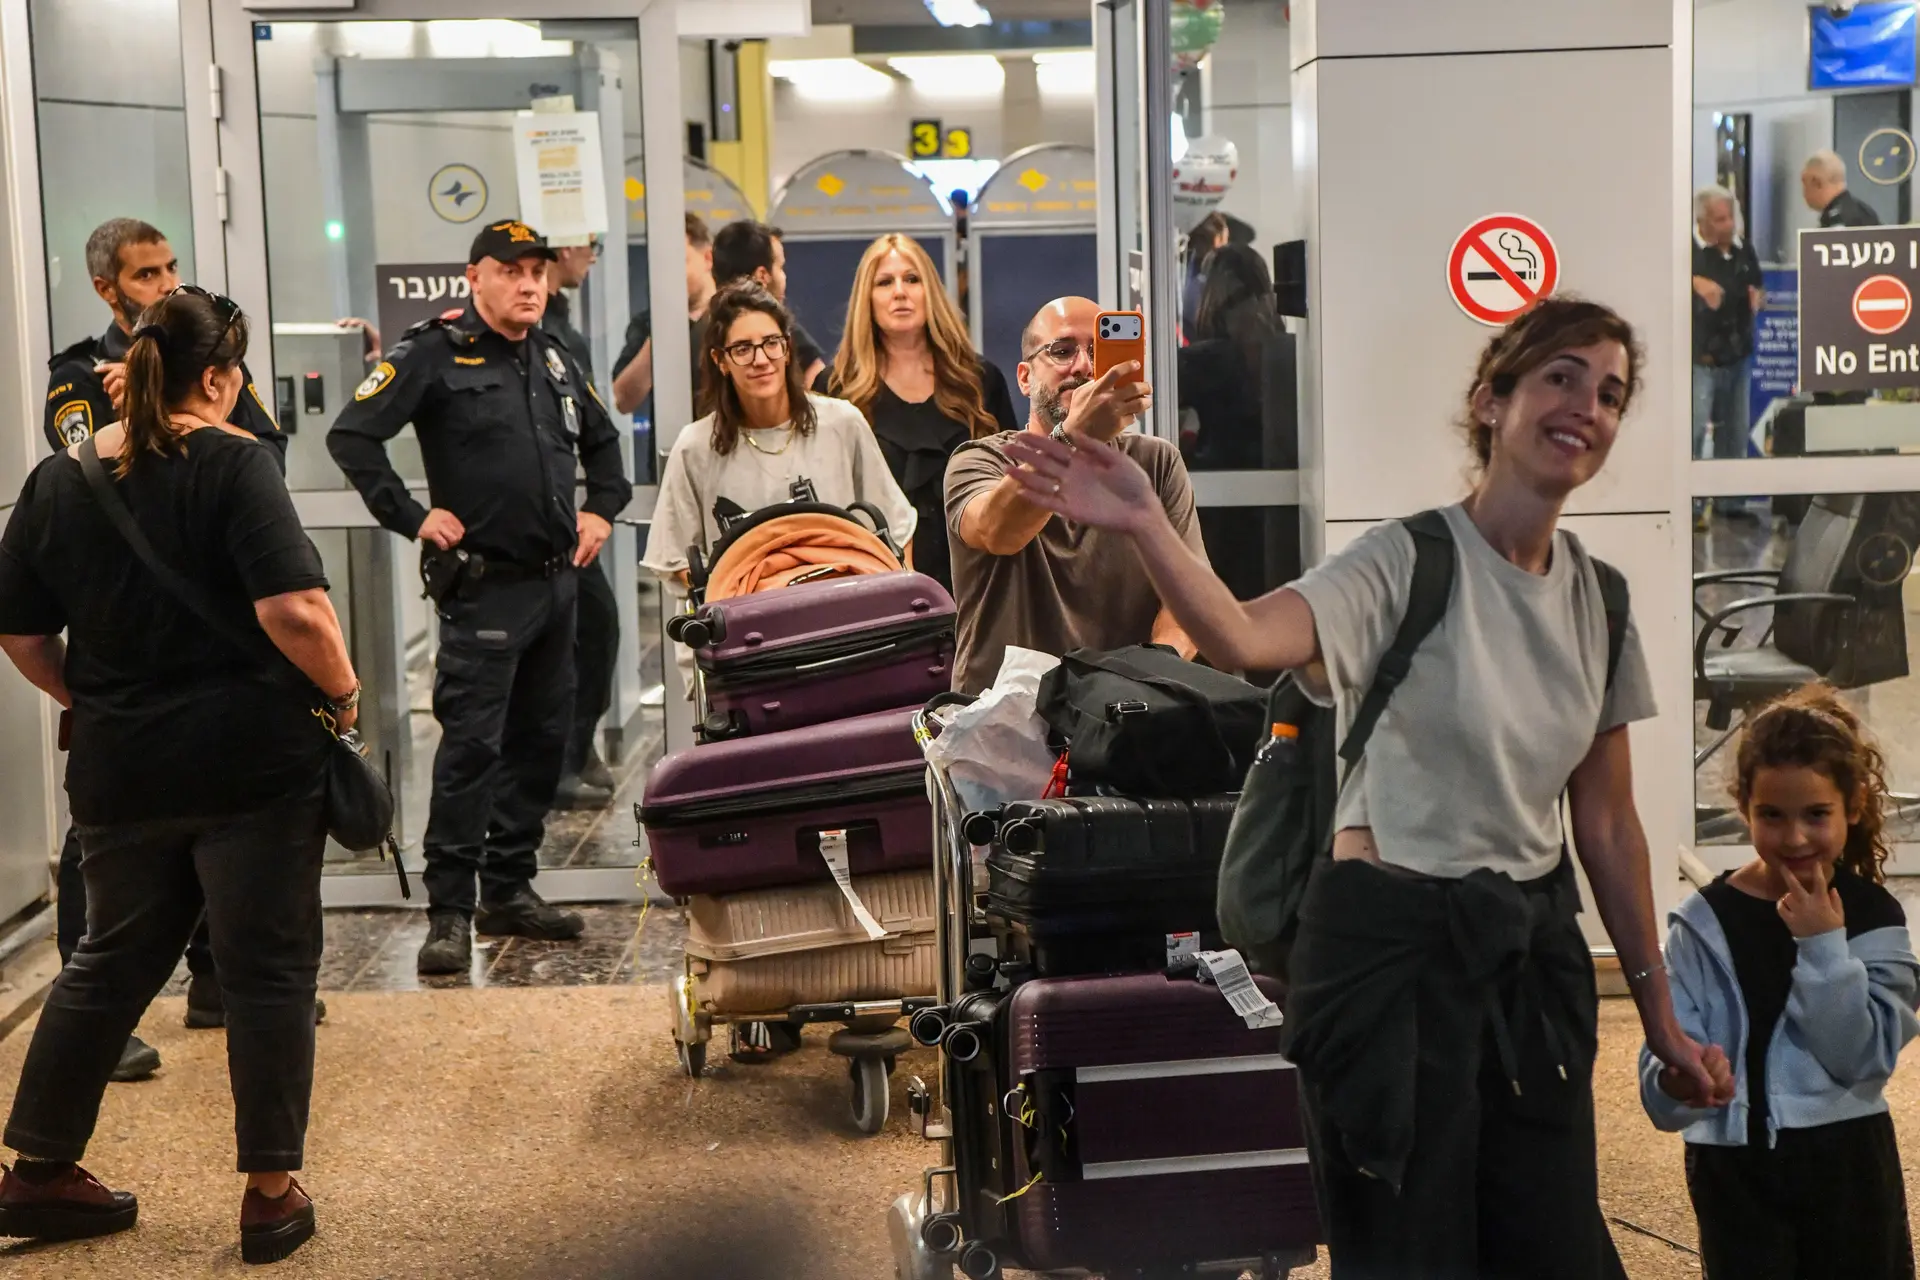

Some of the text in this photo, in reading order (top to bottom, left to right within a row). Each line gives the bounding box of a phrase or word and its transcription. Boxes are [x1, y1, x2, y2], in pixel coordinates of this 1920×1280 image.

[913, 123, 939, 155] 3
[1812, 241, 1896, 268] מעבר
[389, 275, 471, 301] מעבר
[1815, 343, 1919, 375] No Ent
